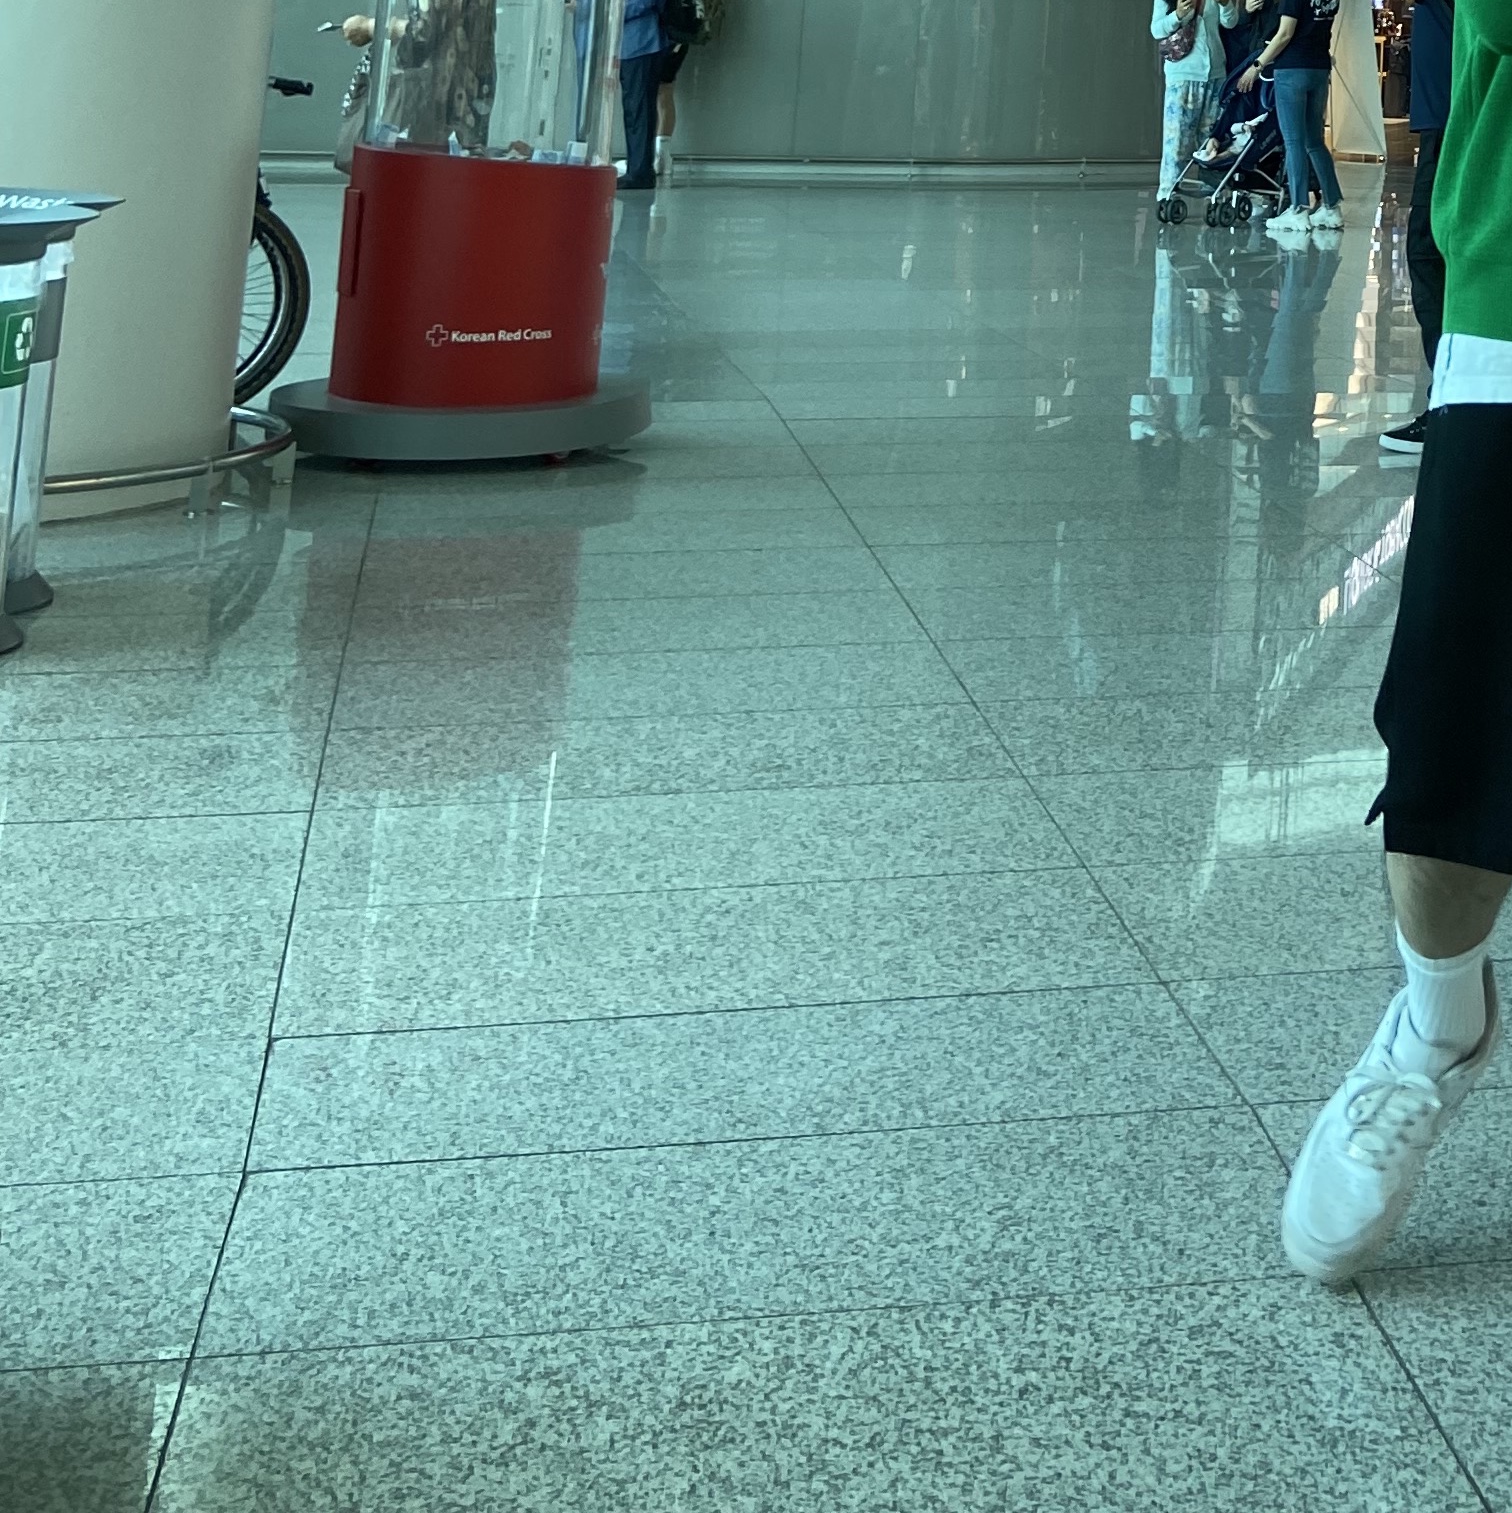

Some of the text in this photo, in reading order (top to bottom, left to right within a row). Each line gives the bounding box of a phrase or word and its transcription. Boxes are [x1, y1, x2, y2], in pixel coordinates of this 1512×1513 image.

[0, 194, 74, 210] Wast
[451, 328, 552, 343] Korean Red Cross
